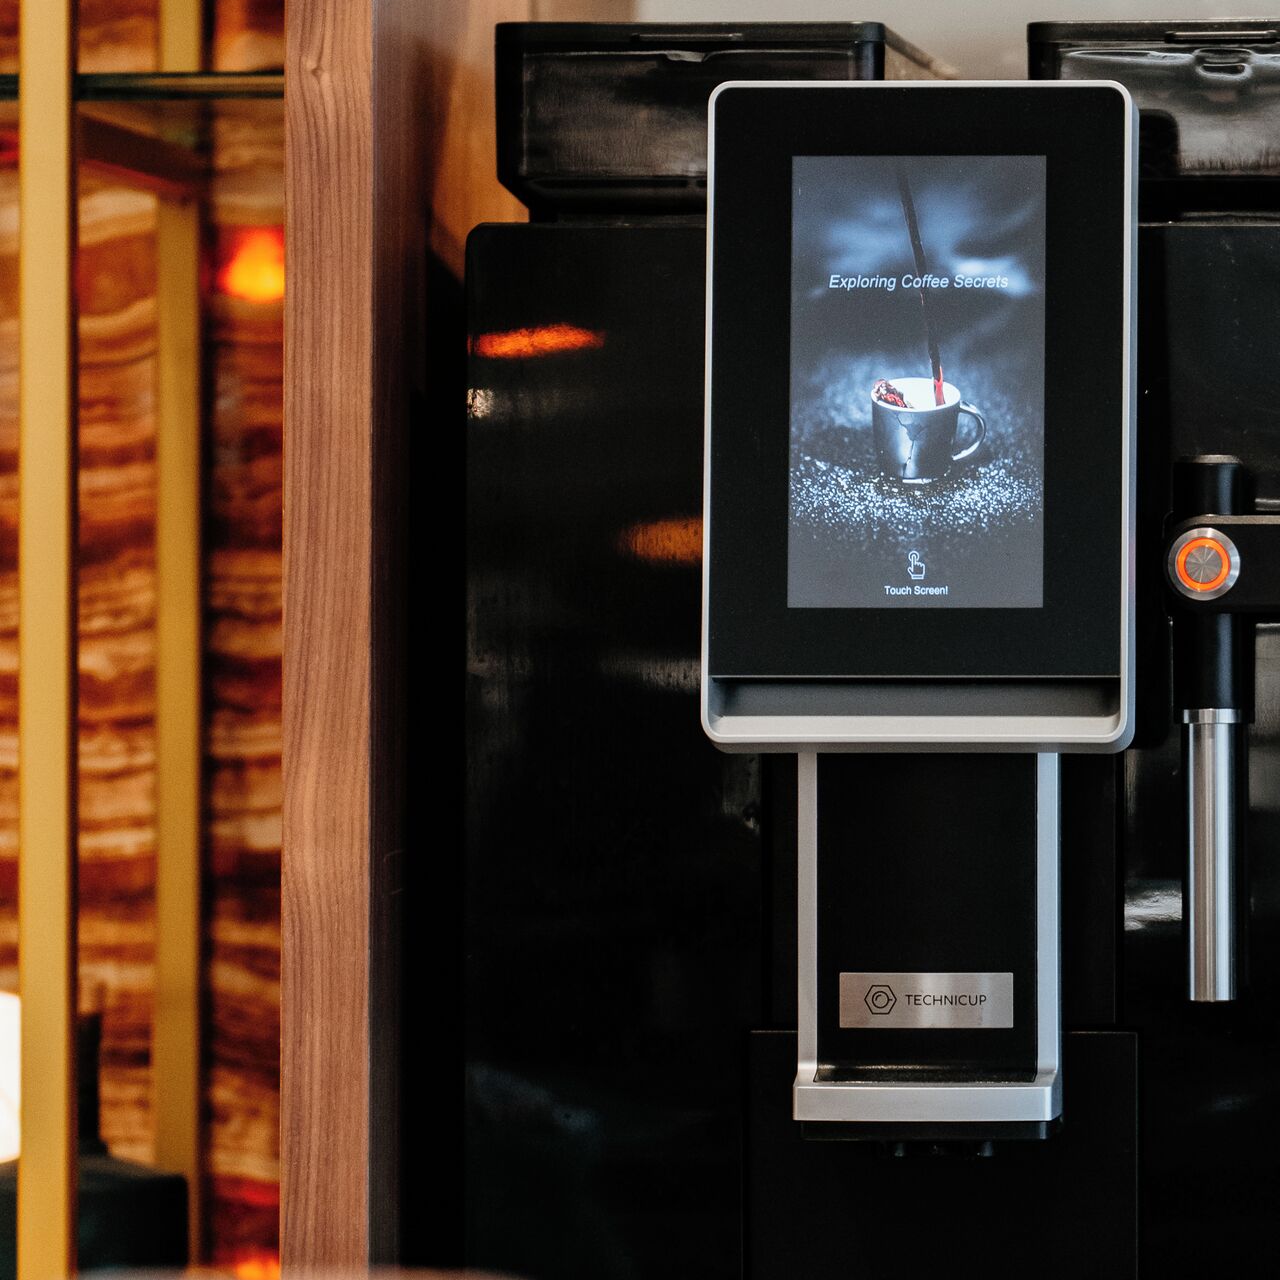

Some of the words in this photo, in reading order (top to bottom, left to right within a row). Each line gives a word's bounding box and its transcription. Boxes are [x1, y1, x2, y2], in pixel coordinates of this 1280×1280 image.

[829, 274, 897, 291] Exploring
[901, 274, 949, 289] Coffee
[953, 274, 1008, 289] Secrets
[884, 585, 912, 595] Touch
[913, 585, 949, 595] Screen!
[905, 994, 987, 1006] TECHNICUP
